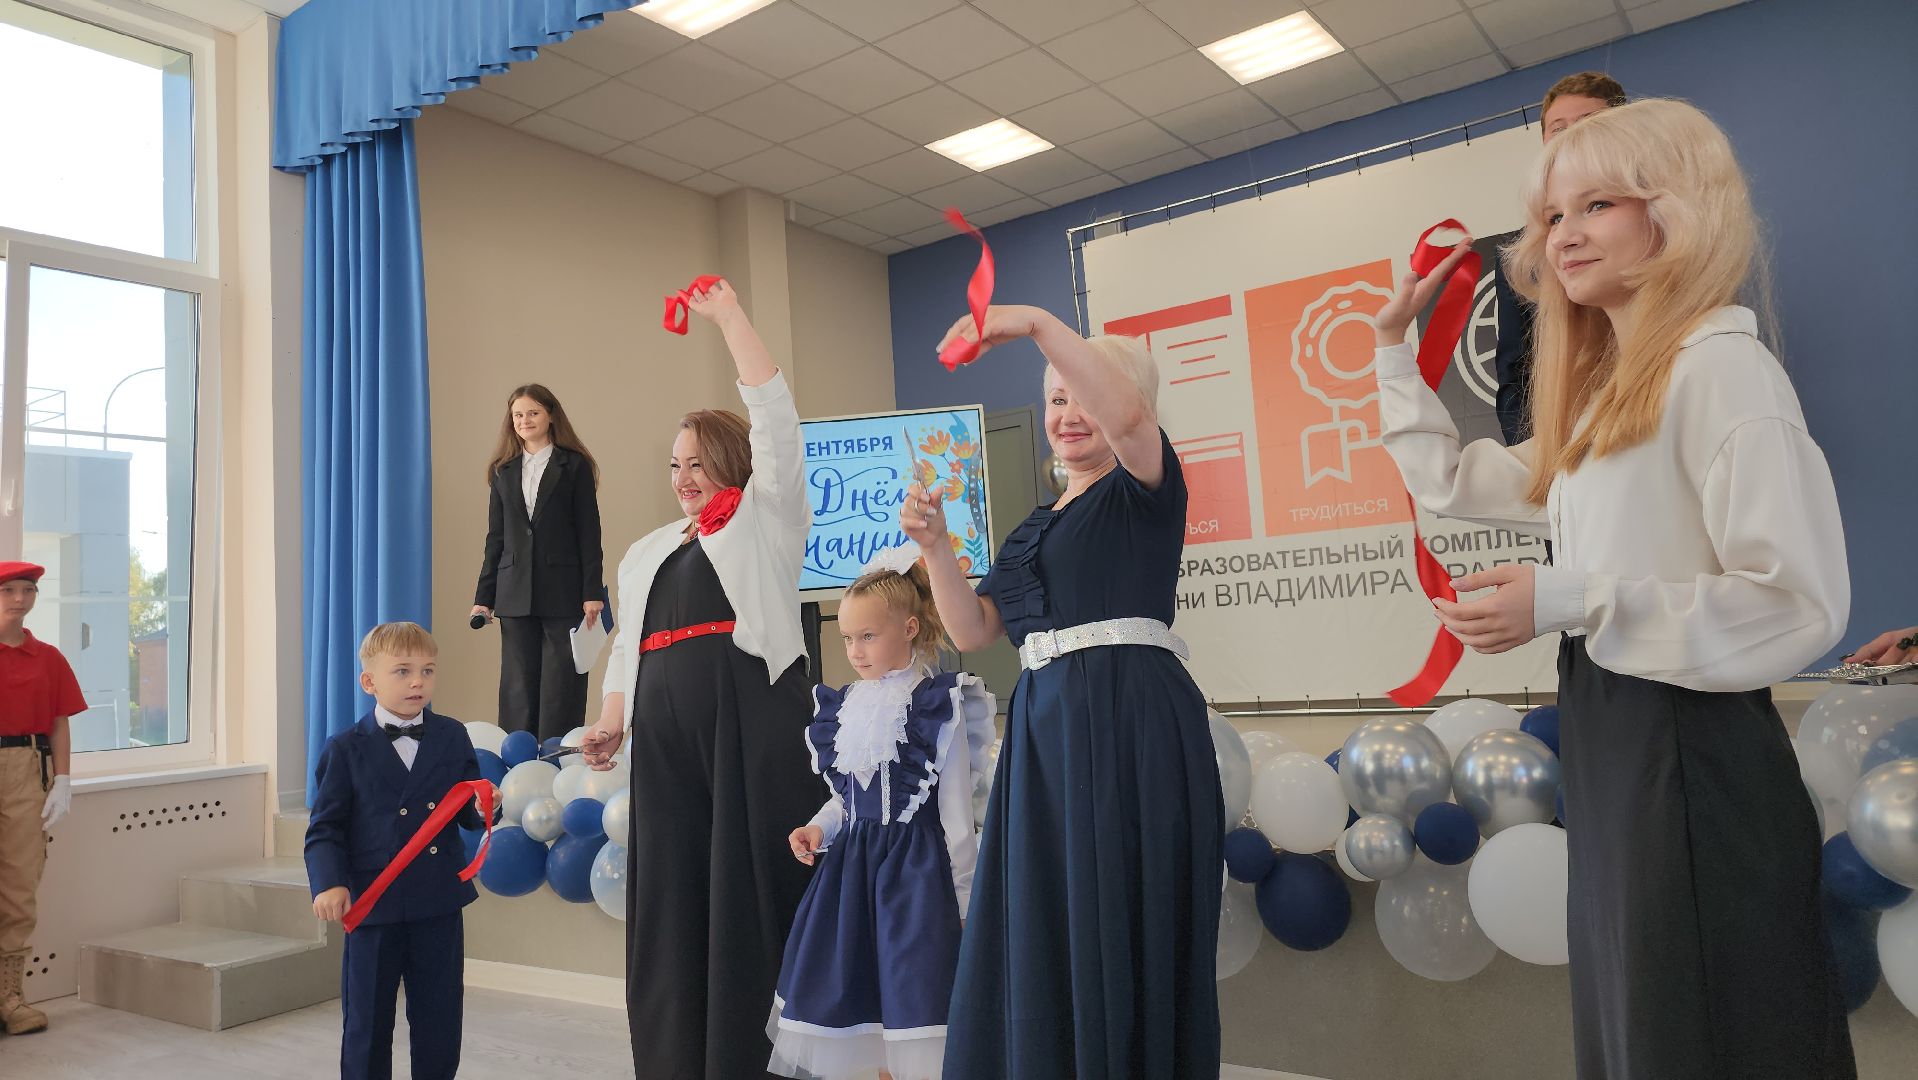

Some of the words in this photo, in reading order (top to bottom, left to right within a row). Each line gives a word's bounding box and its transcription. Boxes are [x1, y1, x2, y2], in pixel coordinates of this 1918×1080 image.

[805, 435, 894, 458] ЕНТЯБРЯ
[1288, 497, 1389, 522] ТРУДИТЬСЯ
[1178, 533, 1404, 578] БРАЗОВАТЕЛЬНЫЙ
[1414, 528, 1542, 557] ОМПЛЕ
[1215, 567, 1414, 608] ВЛАДИМИРА
